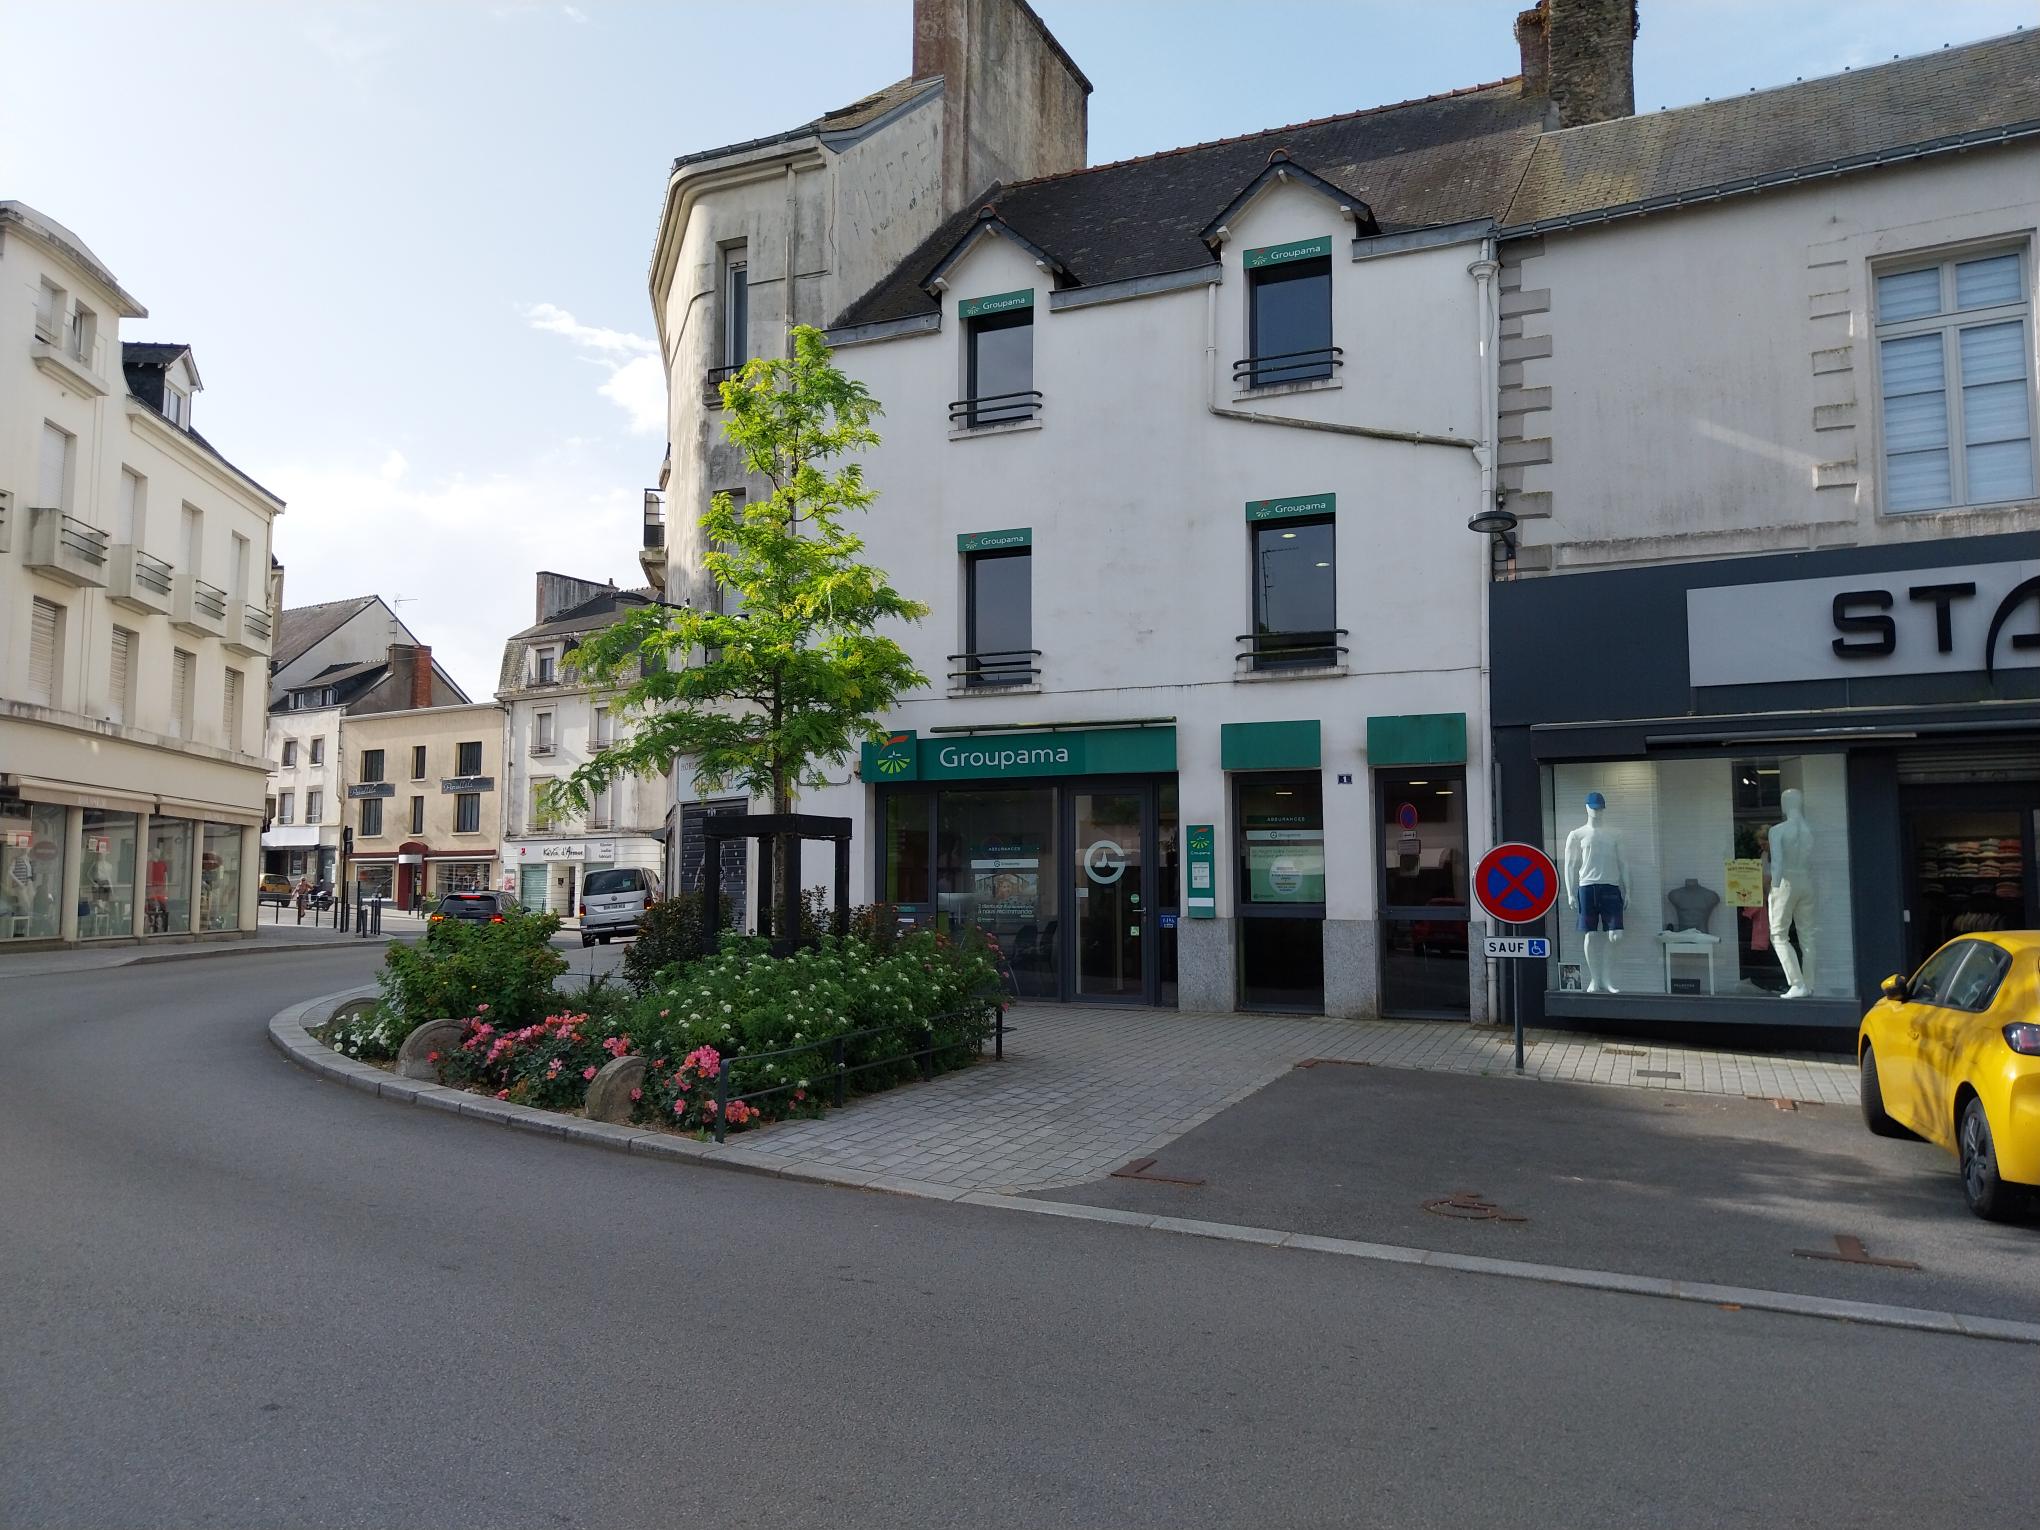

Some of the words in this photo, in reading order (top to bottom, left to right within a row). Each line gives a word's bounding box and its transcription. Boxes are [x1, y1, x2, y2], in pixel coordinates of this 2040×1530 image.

[1270, 246, 1321, 260] Groupama
[982, 297, 1026, 310] Groupama
[1274, 502, 1326, 513] Groupama
[981, 536, 1024, 545] Groupama
[939, 747, 1069, 770] Groupama
[1489, 942, 1525, 953] SAUF
